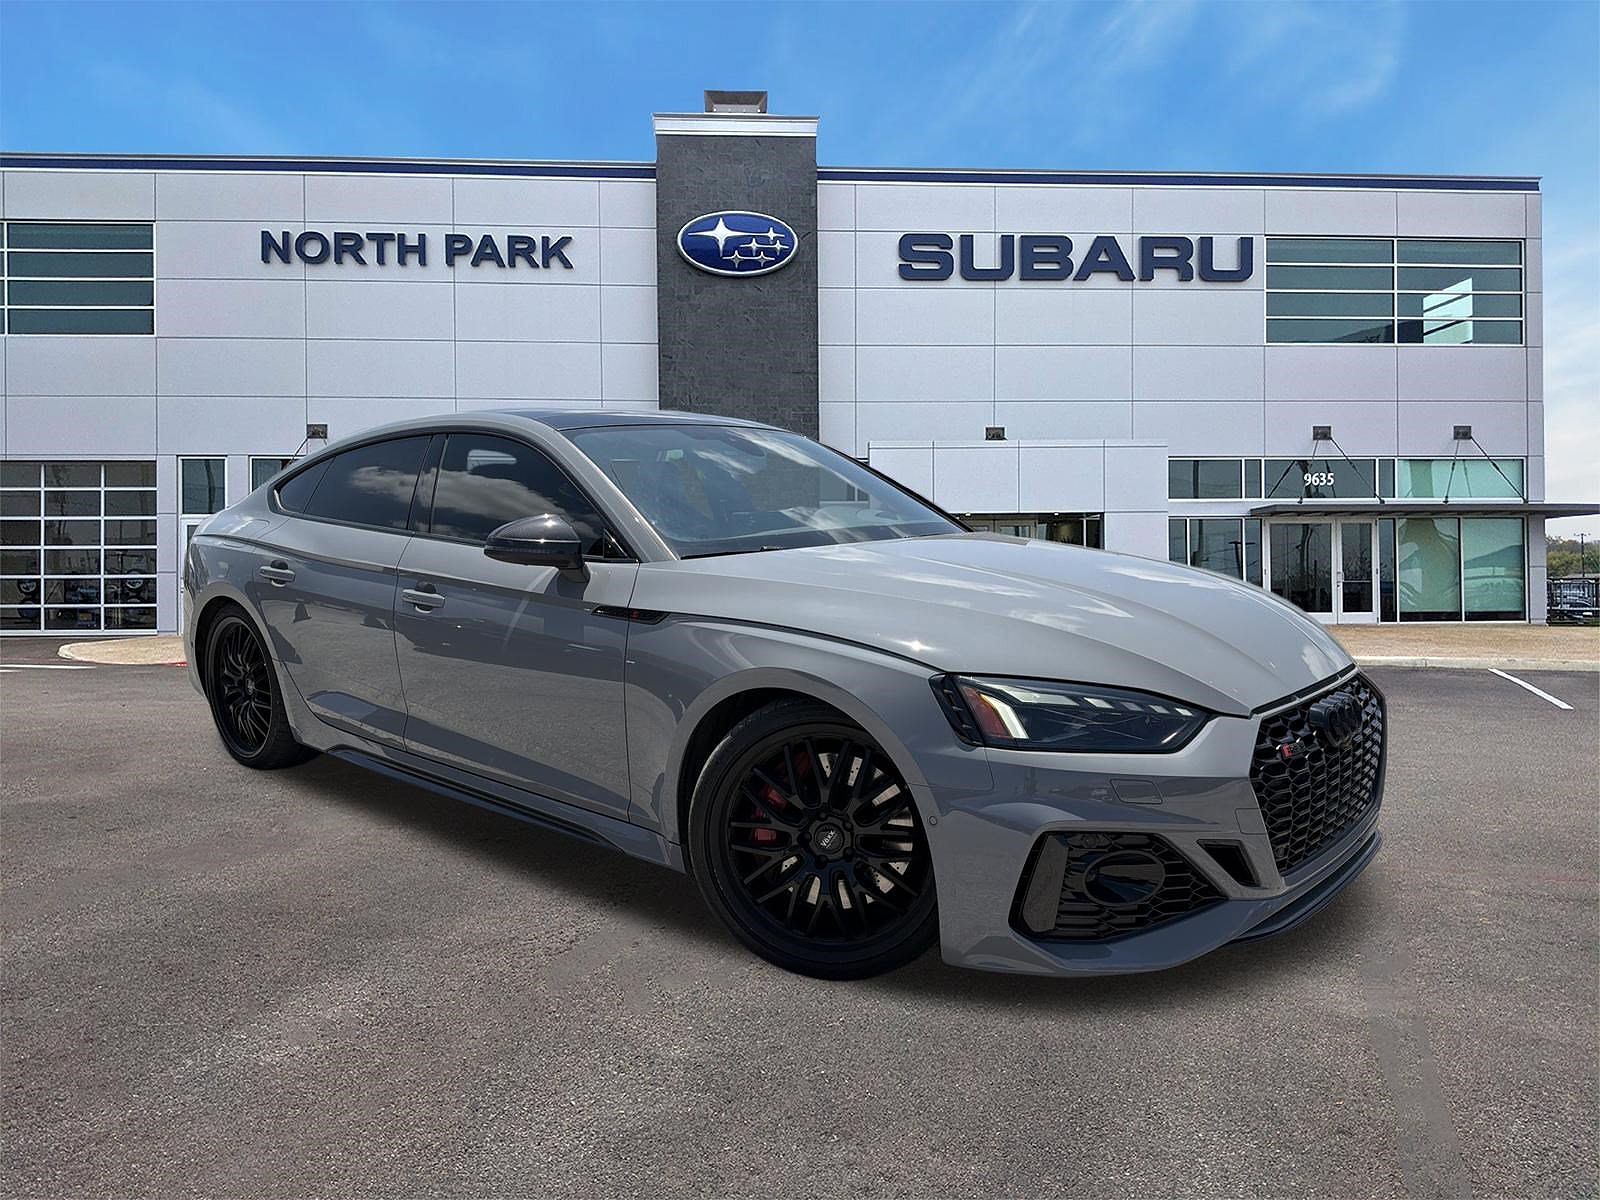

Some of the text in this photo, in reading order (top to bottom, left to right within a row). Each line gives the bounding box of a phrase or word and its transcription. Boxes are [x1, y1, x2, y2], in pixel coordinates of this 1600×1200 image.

[260, 229, 574, 270] NORTH PARK
[898, 232, 1255, 283] SUBARU
[1303, 472, 1335, 487] 9635
